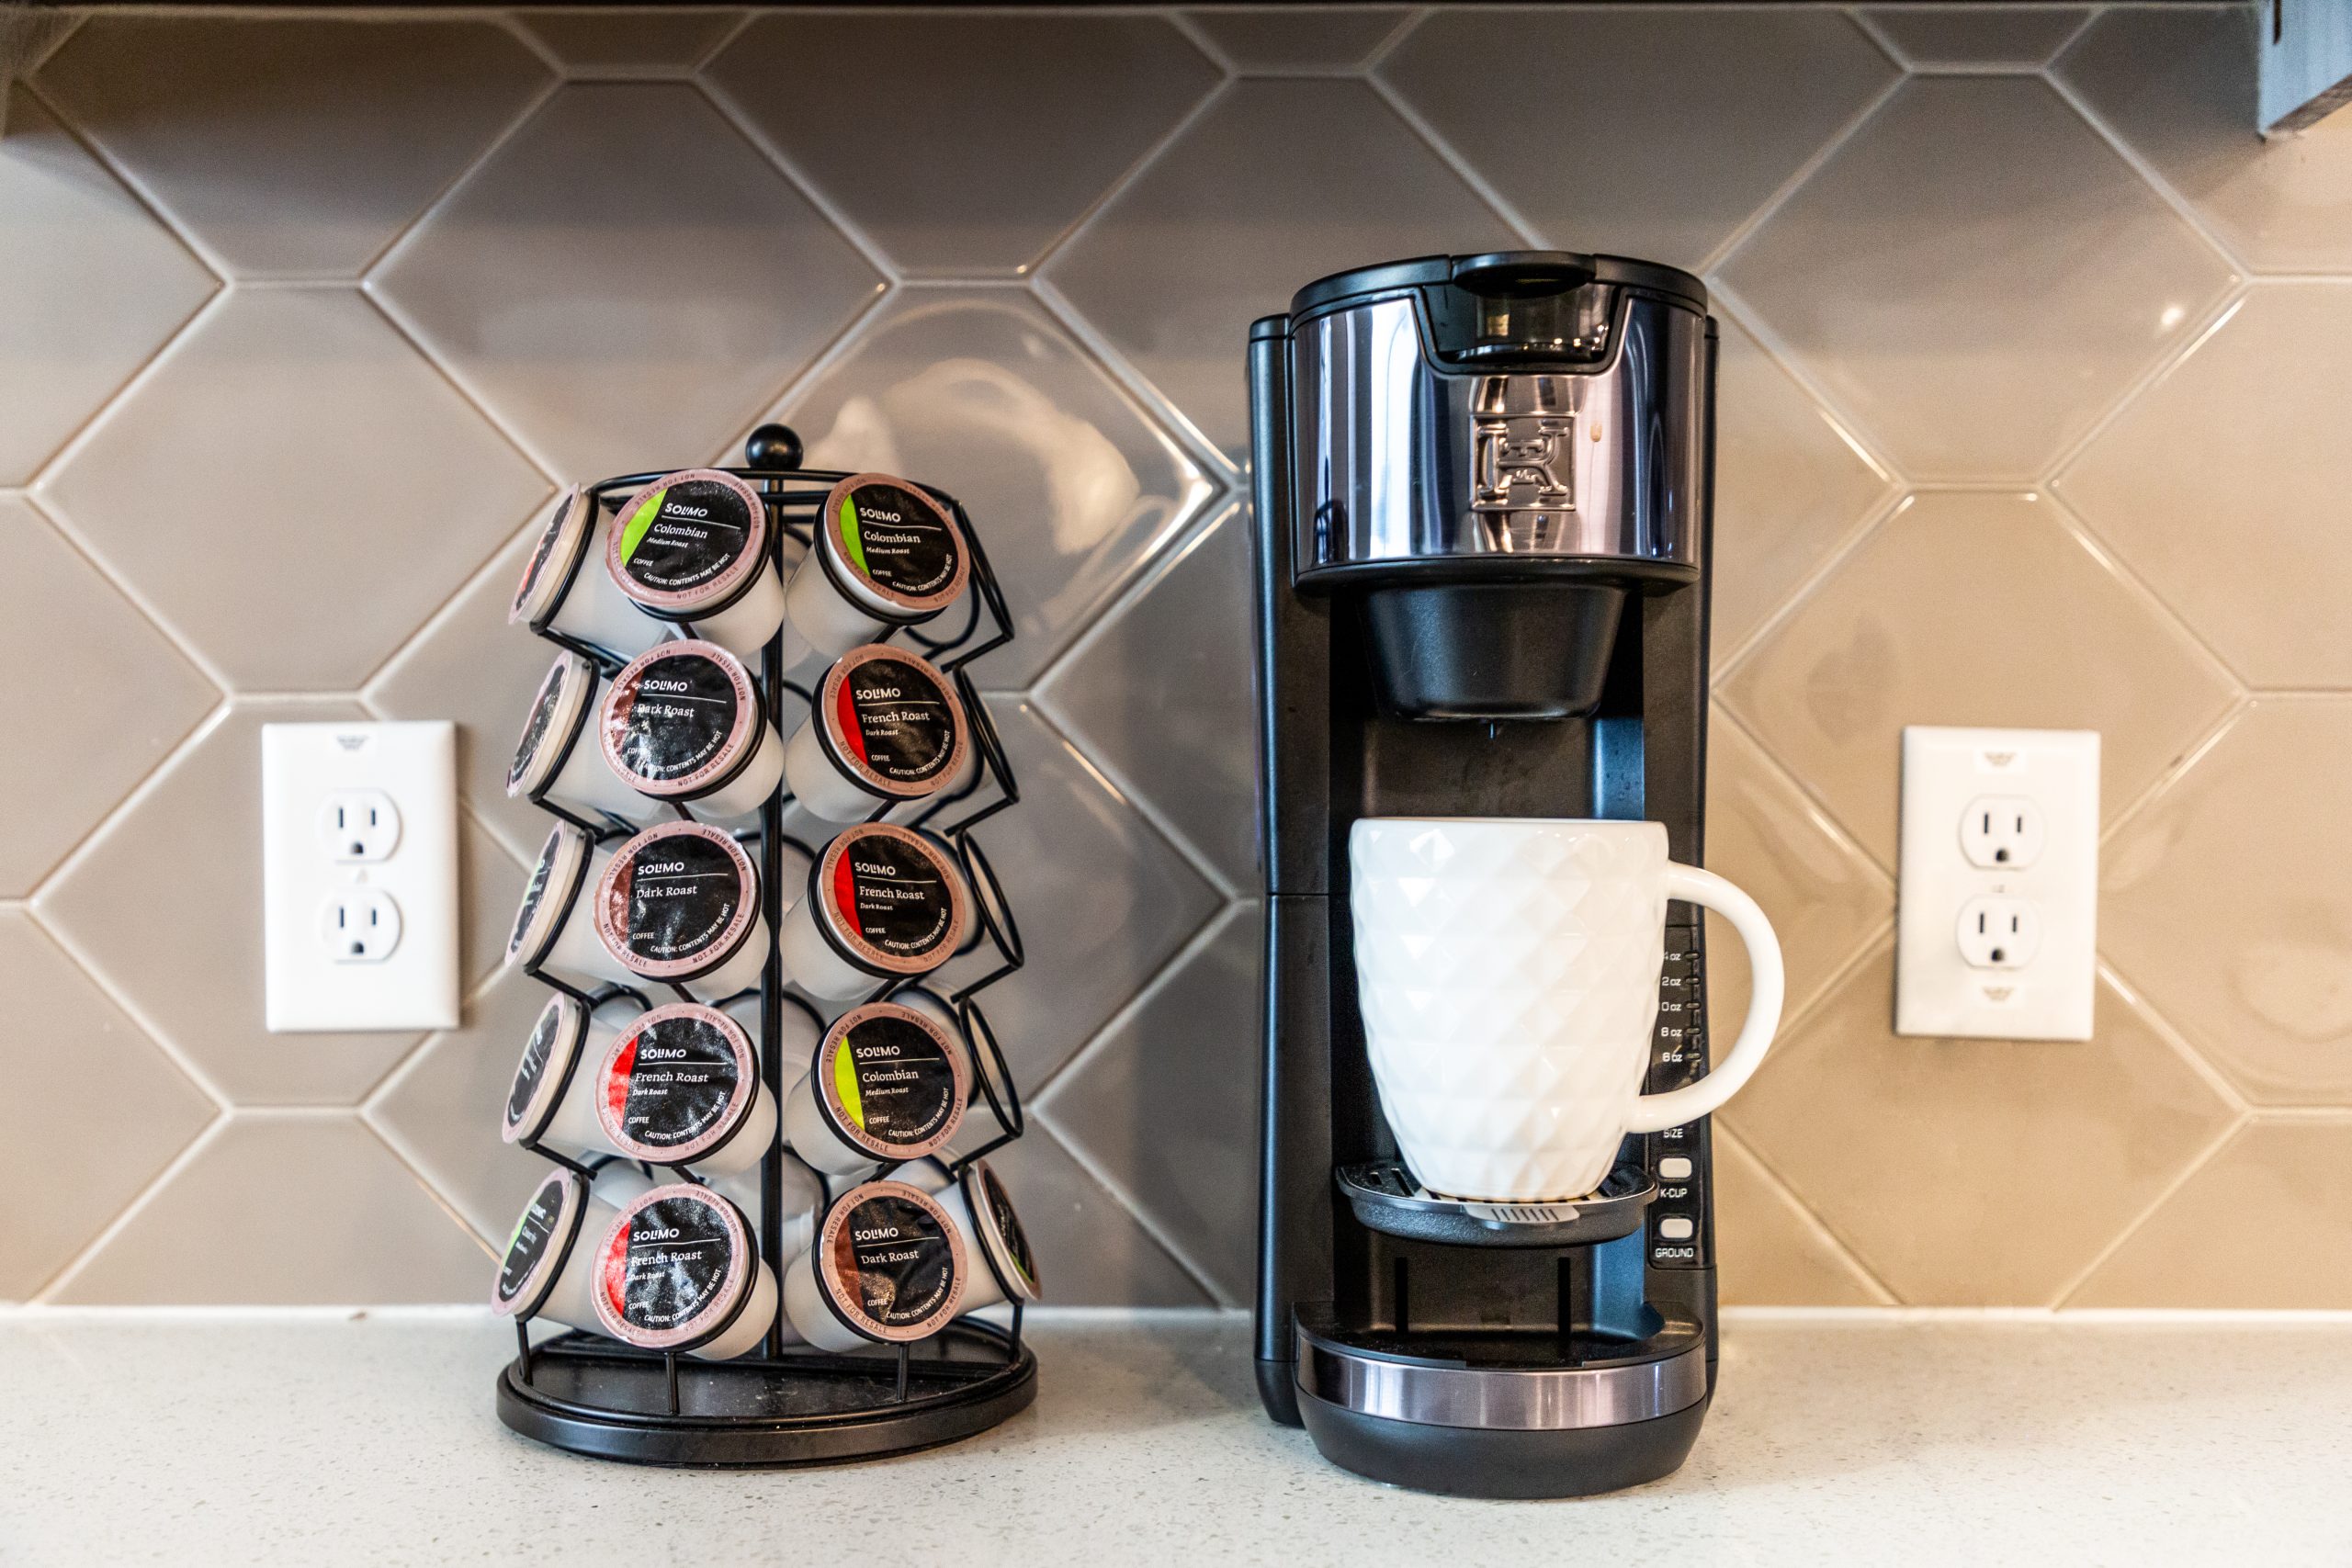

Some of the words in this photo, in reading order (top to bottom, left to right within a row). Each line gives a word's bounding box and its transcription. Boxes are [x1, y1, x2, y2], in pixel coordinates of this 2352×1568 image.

[664, 502, 707, 517] SOLIMO
[860, 507, 901, 523] SOLIMO
[654, 524, 707, 538] Colombian
[865, 531, 921, 543] Colombian
[647, 537, 671, 546] Medium
[633, 558, 653, 566] COFFEE
[644, 572, 668, 584] CAUTION:
[669, 574, 699, 586] CONTENTS
[699, 568, 712, 577] MAY
[712, 561, 720, 571] BE
[719, 553, 730, 566] HOT
[695, 585, 710, 595] FOR
[713, 567, 740, 587] RESALE
[892, 581, 917, 592] CAUTION:
[917, 577, 942, 591] CONTENTS
[939, 570, 947, 580] MAY
[644, 680, 687, 692] SOLIMO
[856, 688, 901, 699] SOLIMO
[637, 704, 662, 714] Dark
[664, 705, 695, 717] Roast
[862, 712, 899, 723] French
[901, 712, 930, 721] Roast
[666, 757, 696, 772] CONTENTS
[695, 750, 707, 761] MAY
[707, 741, 715, 751] BE
[712, 730, 723, 744] HOT
[678, 777, 692, 786] NOT
[695, 769, 709, 780] FOR
[712, 743, 734, 769] RESALE
[889, 767, 915, 775] CAUTION:
[916, 758, 940, 773] CONTENTS
[944, 741, 949, 750] BE
[638, 862, 684, 875] SOLIMO
[854, 863, 896, 875] SOLIMO
[636, 888, 663, 898] Dark
[666, 886, 697, 897] Roast
[859, 886, 894, 898] French
[897, 889, 924, 900] Roast
[679, 934, 708, 952] CONTENTS
[707, 924, 718, 935] MAY
[718, 915, 724, 925] BE
[692, 953, 707, 964] NOT
[709, 941, 723, 953] FOR
[725, 913, 744, 940] RESALE
[885, 940, 910, 949] CAUTION:
[910, 933, 934, 948] CONTENTS
[933, 924, 942, 936] MAY
[939, 916, 945, 926] BE
[1661, 976, 1668, 986] 2
[1661, 1002, 1668, 1010] 0
[850, 1014, 862, 1024] NOT
[838, 1024, 850, 1037] FOR
[1661, 1027, 1668, 1036] 8
[640, 1049, 686, 1059] SOLIMO
[827, 1038, 838, 1063] RESALE
[856, 1046, 900, 1057] SOLIMO
[1663, 1053, 1670, 1062] 6
[635, 1072, 673, 1082] French
[675, 1074, 708, 1083] Roast
[863, 1070, 919, 1083] Colombian
[865, 1089, 890, 1097] Medium
[645, 1131, 672, 1140] CAUTION:
[673, 1121, 702, 1138] CONTENTS
[701, 1111, 713, 1122] MAY
[711, 1103, 719, 1113] BE
[717, 1091, 726, 1104] HOT
[869, 1116, 889, 1124] COFFEE
[888, 1129, 914, 1137] CAUTION:
[914, 1118, 937, 1135] CONTENTS
[936, 1109, 944, 1120] MAY
[942, 1100, 947, 1109] BE
[836, 1106, 847, 1120] NOT
[848, 1122, 860, 1135] FOR
[862, 1131, 888, 1152] RESALE
[929, 1135, 941, 1147] NOT
[942, 1125, 953, 1137] FOR
[952, 1098, 963, 1123] RESALE
[852, 1195, 864, 1205] NOT
[1660, 1189, 1688, 1198] K-CUP
[840, 1205, 851, 1216] FOR
[633, 1228, 679, 1241] SOLIMO
[828, 1217, 841, 1243] RESALE
[855, 1227, 899, 1240] SOLIMO
[631, 1253, 668, 1267] French
[671, 1251, 702, 1261] Roast
[861, 1254, 887, 1264] Dark
[889, 1250, 919, 1262] Roast
[1656, 1248, 1694, 1258] GROUND
[647, 1271, 665, 1280] Roast
[673, 1301, 699, 1321] CONTENTS
[698, 1291, 709, 1303] MAY
[707, 1281, 716, 1292] BE
[712, 1269, 721, 1283] HOT
[911, 1299, 936, 1317] CONTENTS
[940, 1280, 946, 1290] BE
[628, 1302, 649, 1310] COFFEE
[927, 1317, 938, 1328] NOT
[939, 1304, 950, 1318] FOR
[949, 1278, 961, 1303] RESALE
[836, 1288, 847, 1301] NOT
[847, 1304, 860, 1317] FOR
[861, 1316, 888, 1334] RESALE
